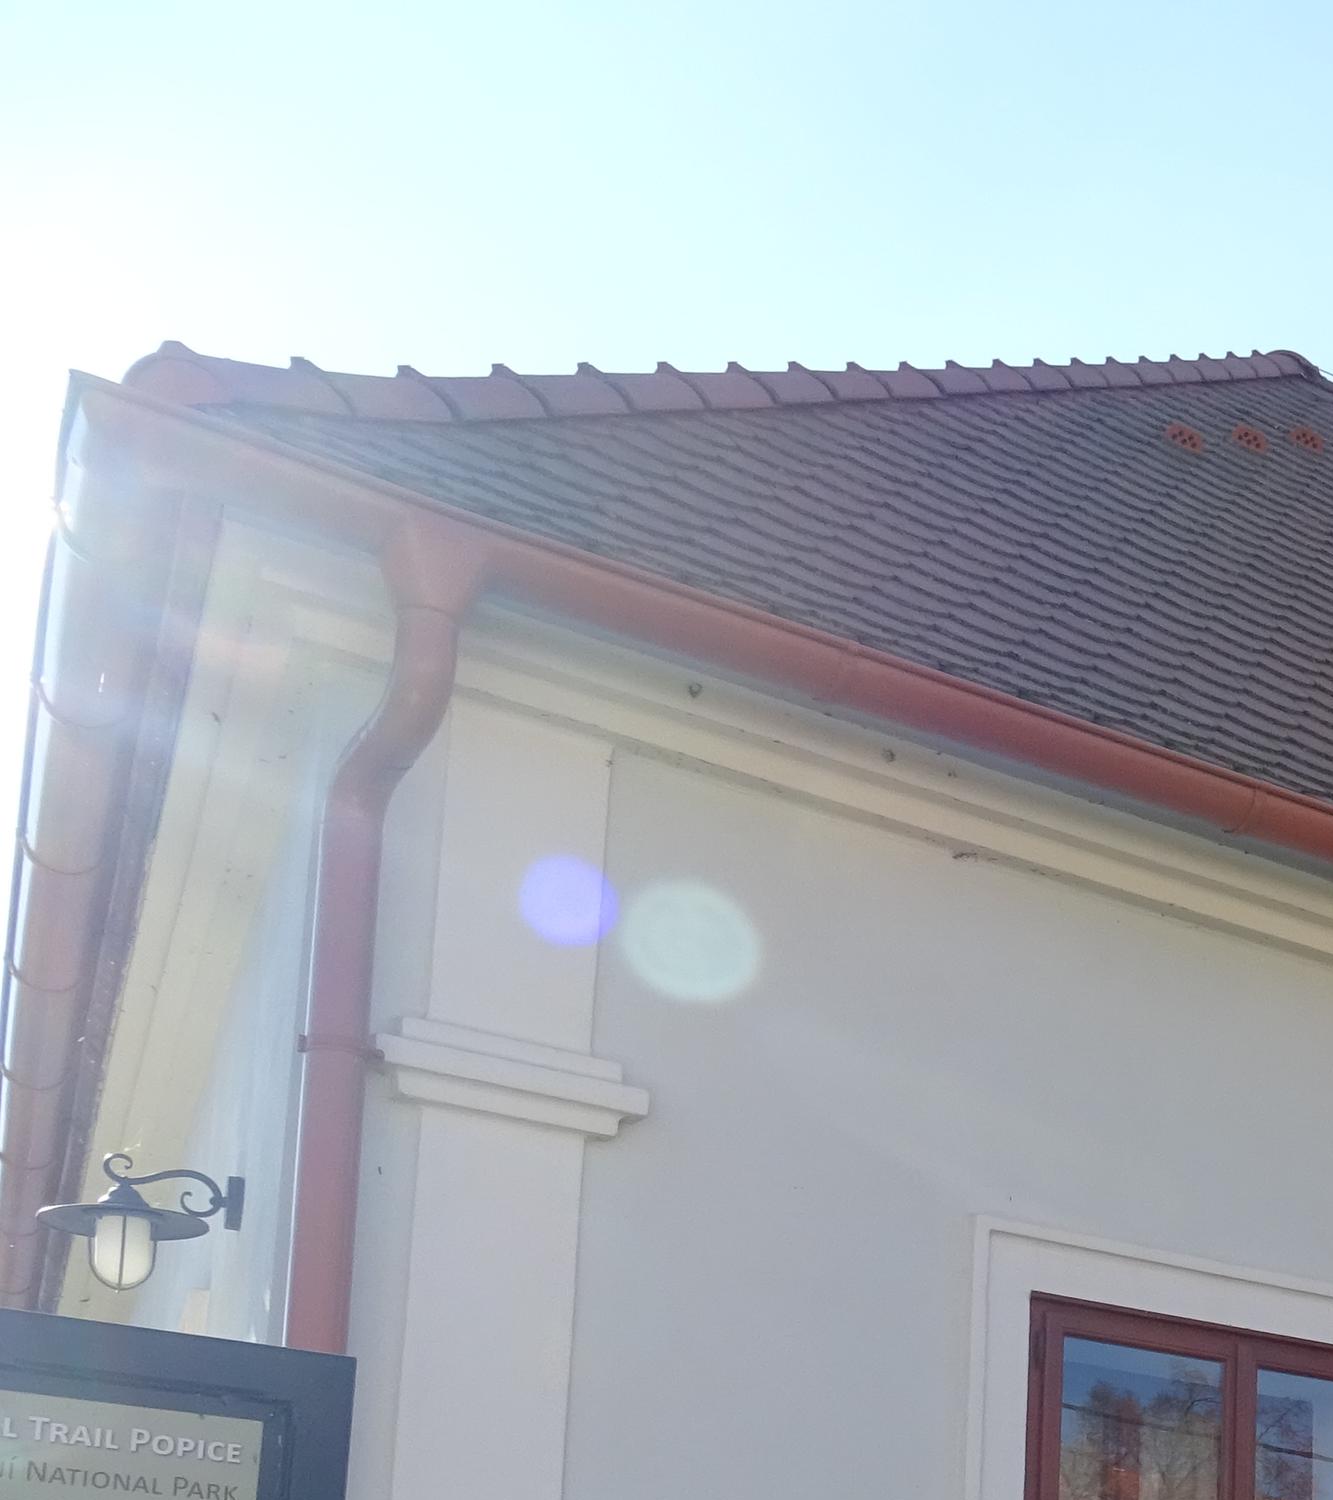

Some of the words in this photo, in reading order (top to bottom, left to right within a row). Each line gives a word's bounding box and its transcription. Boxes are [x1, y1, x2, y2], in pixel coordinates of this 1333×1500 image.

[28, 1415, 119, 1450] TRAIL
[130, 1428, 243, 1464] POPICE
[26, 1460, 163, 1495] NATIONAL
